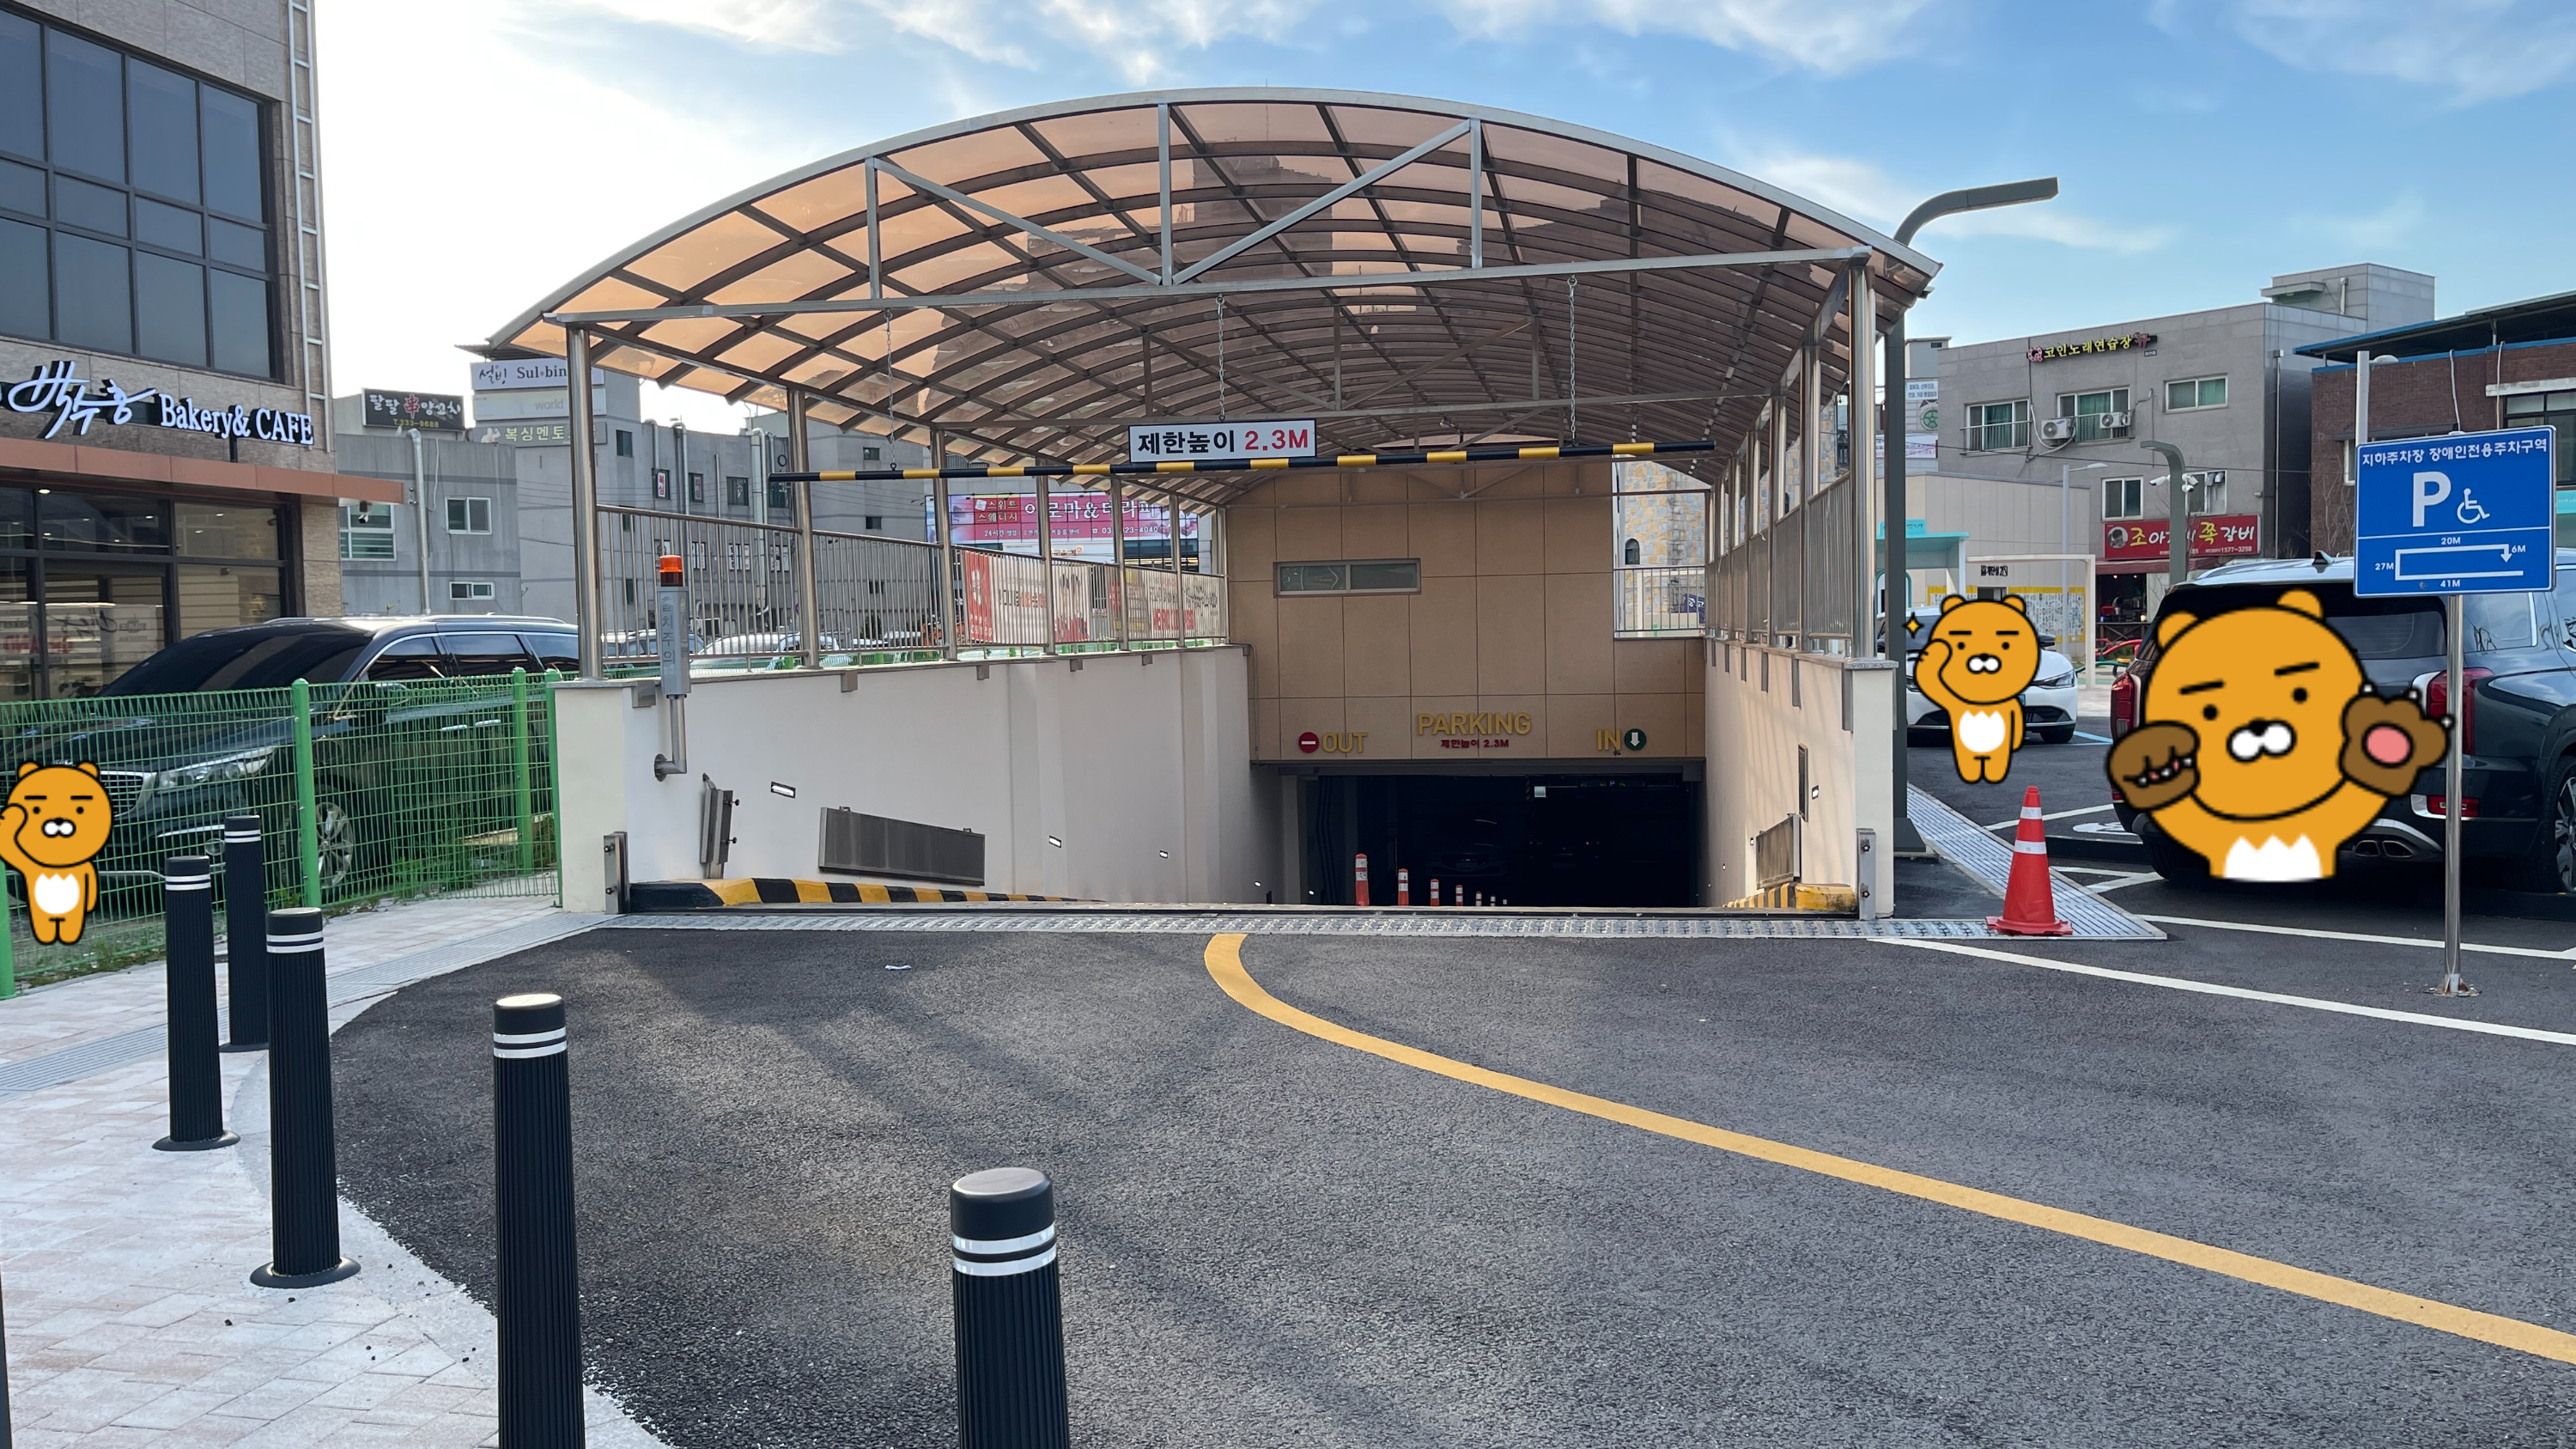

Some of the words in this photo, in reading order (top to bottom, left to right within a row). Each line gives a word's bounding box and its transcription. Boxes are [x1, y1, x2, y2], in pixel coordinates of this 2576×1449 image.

[2044, 334, 2132, 358] 코인노래연습장
[478, 364, 507, 385] 설빙
[535, 398, 564, 411] world
[257, 408, 314, 445] CAFE
[505, 425, 571, 442] 복싱멘토
[1138, 429, 1235, 454] 제한높이
[1245, 429, 1308, 452] 2.3M
[2362, 449, 2425, 467] 지하주차장
[2429, 438, 2548, 461] 장애인전용주차구역
[987, 499, 1018, 510] 스위트
[2412, 471, 2451, 527] P
[2440, 536, 2461, 545] 20M
[2511, 545, 2526, 554] 6M
[2374, 563, 2394, 571] 27M
[2439, 579, 2461, 588] 41M
[1417, 712, 1531, 736] PARKING
[1321, 731, 1369, 753] OUT
[1440, 738, 1480, 749] 제한높이
[1484, 738, 1510, 749] 2.3M
[1596, 728, 1622, 751] IN
